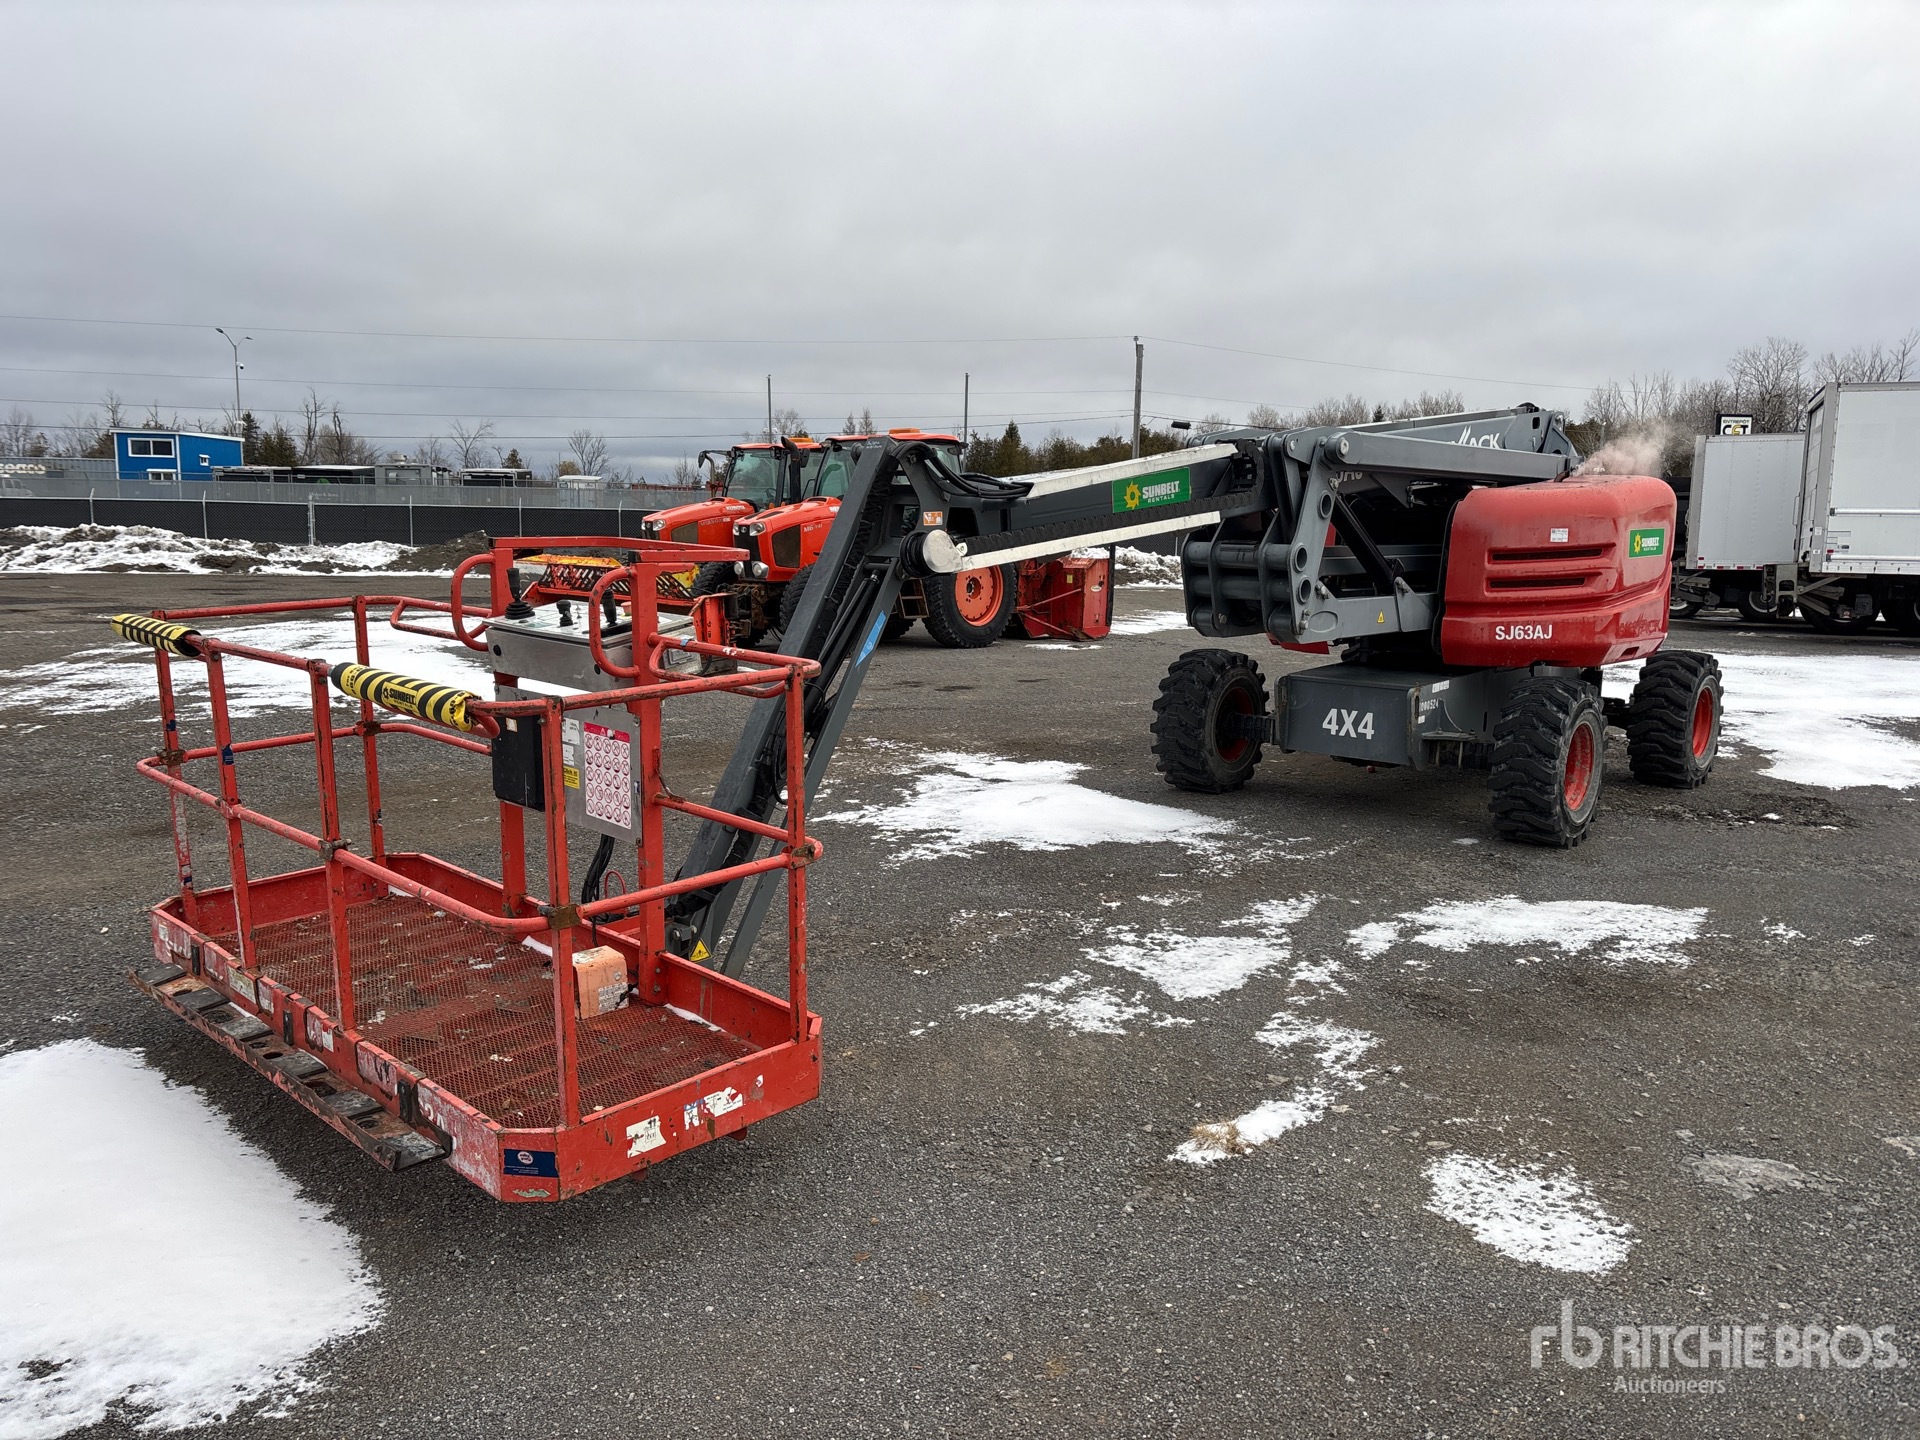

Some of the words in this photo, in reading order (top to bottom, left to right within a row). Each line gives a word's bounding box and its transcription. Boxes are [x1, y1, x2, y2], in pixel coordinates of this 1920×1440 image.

[1142, 480, 1180, 499] SUNBELT
[1147, 493, 1175, 503] RENTALS
[1495, 625, 1553, 640] SJ63AJ
[389, 688, 416, 705] SUNBELT
[1322, 708, 1374, 740] 4X4
